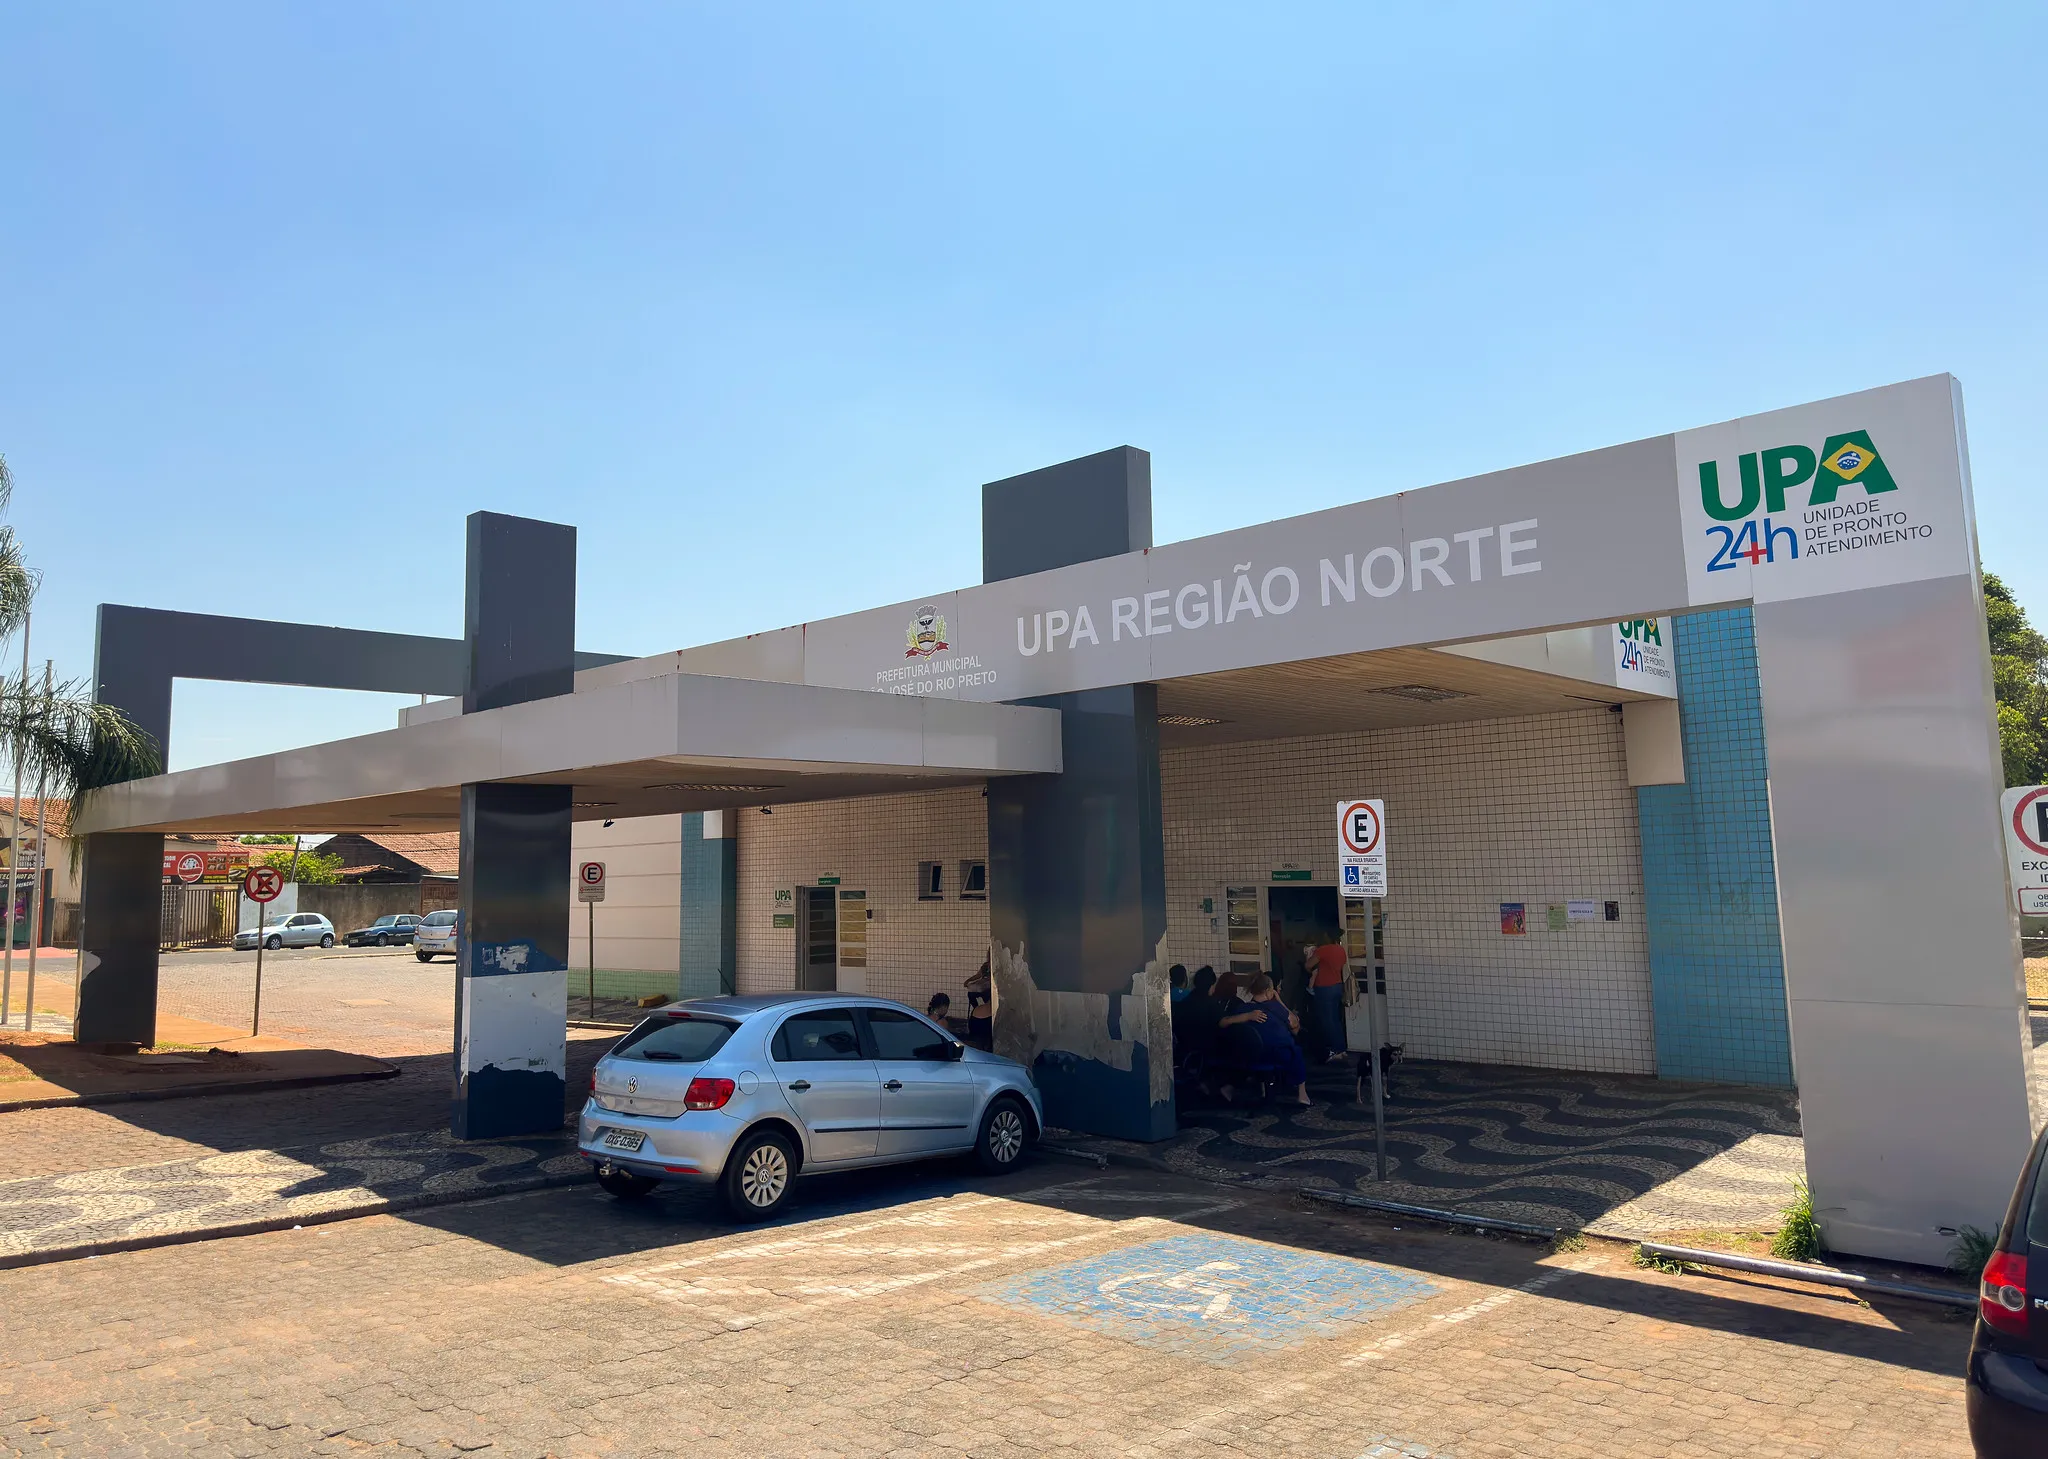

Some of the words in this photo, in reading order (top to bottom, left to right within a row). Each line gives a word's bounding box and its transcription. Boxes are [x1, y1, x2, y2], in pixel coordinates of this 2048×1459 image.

[1698, 429, 1899, 521] UPA
[1803, 499, 1880, 525] UNIDADE
[1804, 526, 1827, 541] DE
[1832, 512, 1907, 537] PRONTO
[1705, 517, 1798, 572] 24h
[1806, 524, 1933, 557] ATENDIMENTO
[1015, 602, 1100, 657] UPA
[1111, 562, 1300, 643] REGIÃO
[1320, 518, 1543, 607] NORTE
[1619, 638, 1644, 673] 24h
[1642, 645, 1660, 657] UNIDADE
[1643, 655, 1649, 665] DE
[1649, 655, 1666, 668] PRONTO
[876, 663, 931, 684] PREFEITURA
[932, 655, 982, 675] MUNICIPAL
[917, 680, 933, 694] DO
[936, 677, 955, 692] RIO
[958, 670, 997, 688] PRETO
[1644, 665, 1671, 679] ATENDIMENTO
[1354, 813, 1369, 843] E
[587, 867, 598, 881] E
[775, 889, 792, 901] UPA
